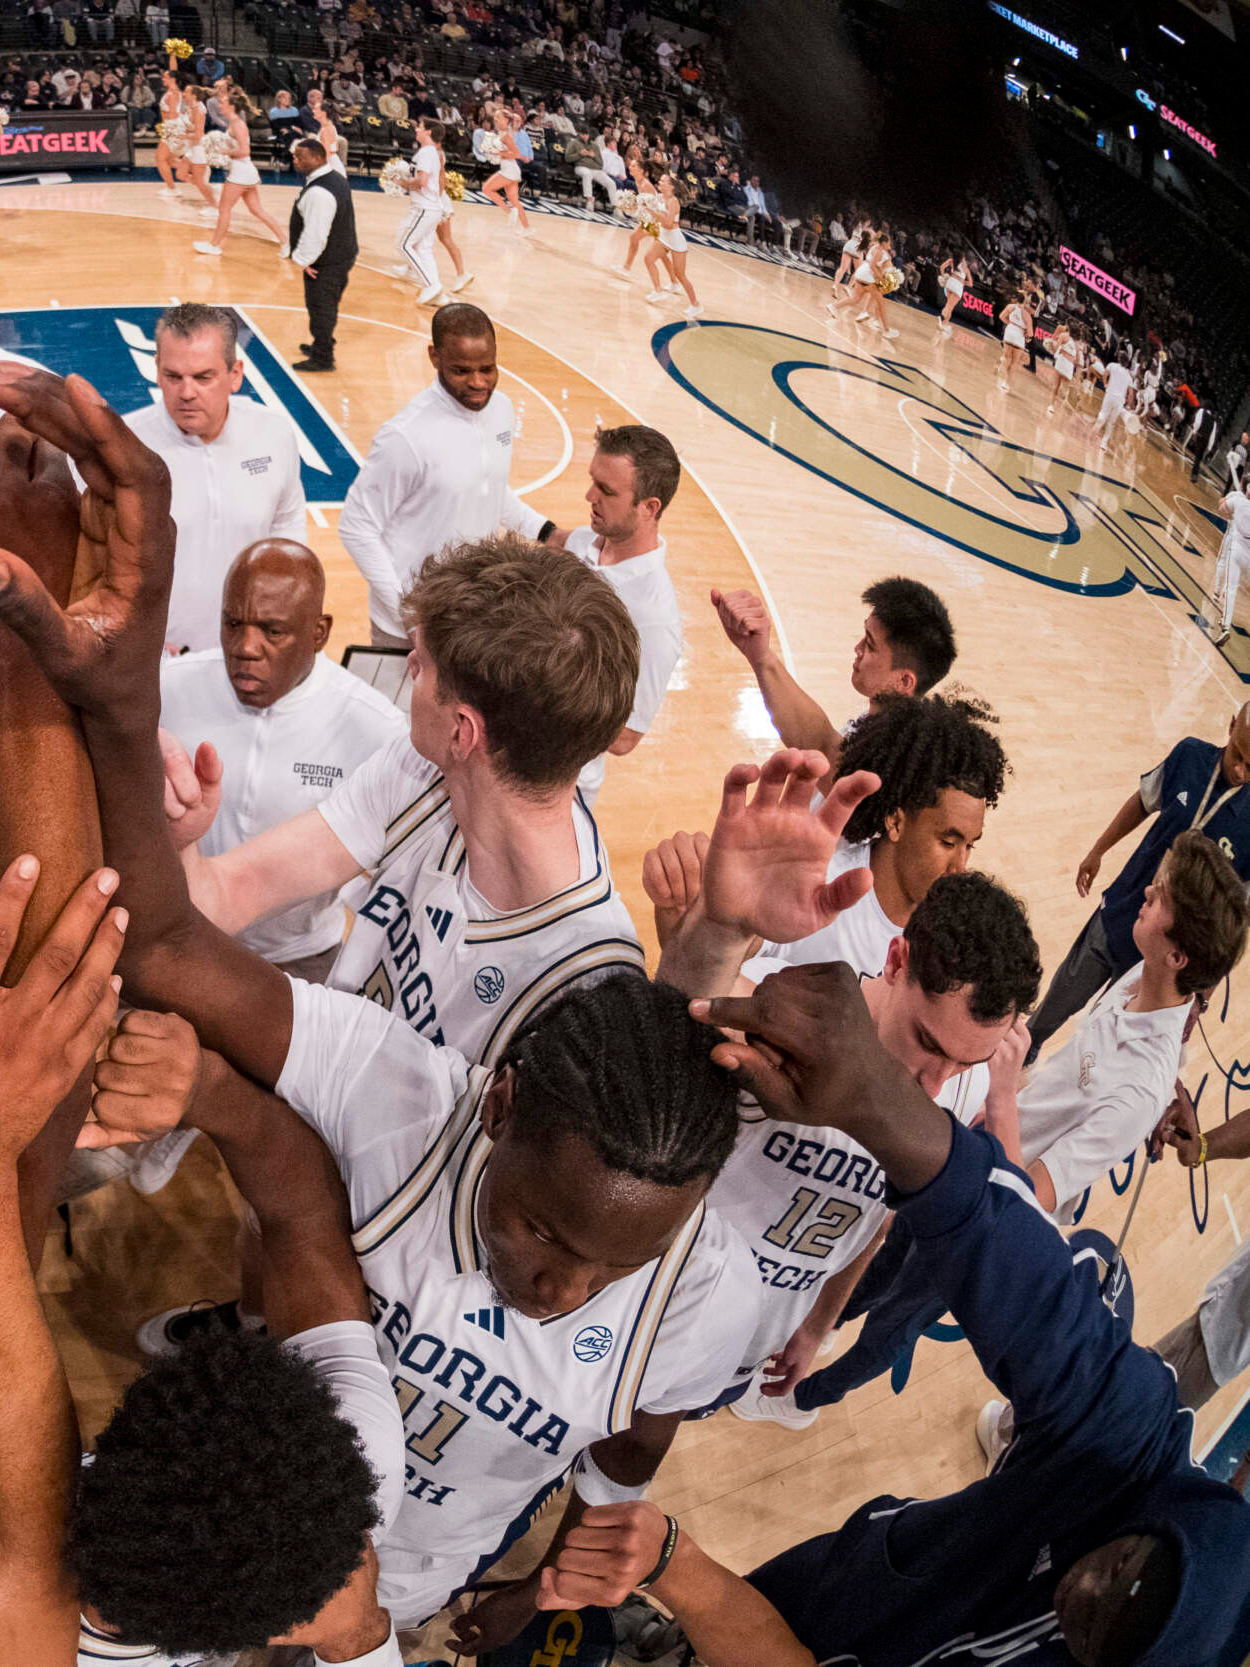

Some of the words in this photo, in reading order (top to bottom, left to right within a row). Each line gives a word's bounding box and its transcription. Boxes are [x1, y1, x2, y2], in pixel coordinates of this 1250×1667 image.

[1012, 13, 1078, 59] MARKETPLACE
[1159, 104, 1217, 158] SEATGEEK
[963, 291, 994, 317] SEATGE
[1062, 252, 1131, 310] SEATGEEK
[293, 763, 343, 778] GEORGIA
[301, 775, 333, 788] TECH
[762, 1130, 886, 1205] GEORG
[761, 1186, 862, 1259] 12
[750, 1246, 827, 1291] ECH
[577, 1336, 612, 1349] ACC
[366, 1287, 570, 1456] GEORGIA
